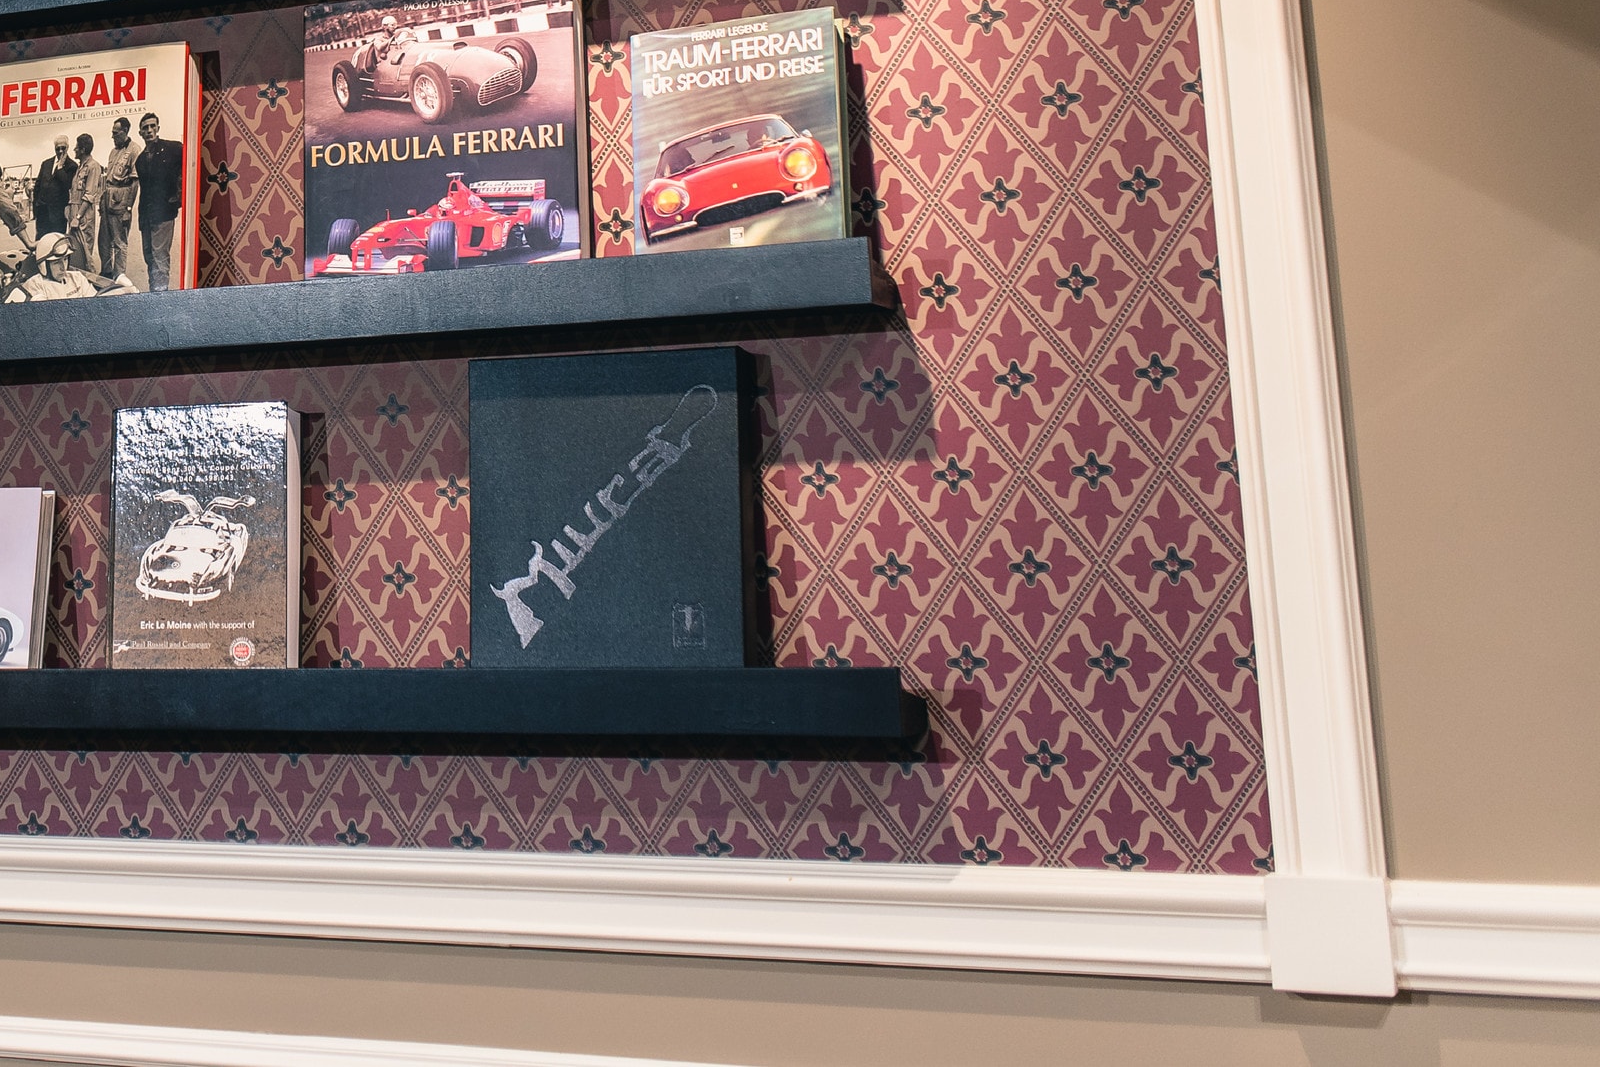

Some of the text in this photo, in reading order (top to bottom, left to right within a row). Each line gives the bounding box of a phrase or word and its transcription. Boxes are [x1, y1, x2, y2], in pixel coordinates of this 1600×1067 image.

[403, 1, 429, 11] PAOLO
[691, 22, 769, 42] FERRARI LEGENDE
[641, 27, 824, 74] TRAUM-FERRARI
[642, 55, 825, 97] FÜR SPORT UND REISE
[1, 68, 147, 117] FERRARI
[71, 112, 87, 120] THE
[90, 109, 120, 118] GOLDEN
[310, 122, 565, 168] FORMULA FERRARI
[140, 620, 255, 631] Eric Le Moine with the support of
